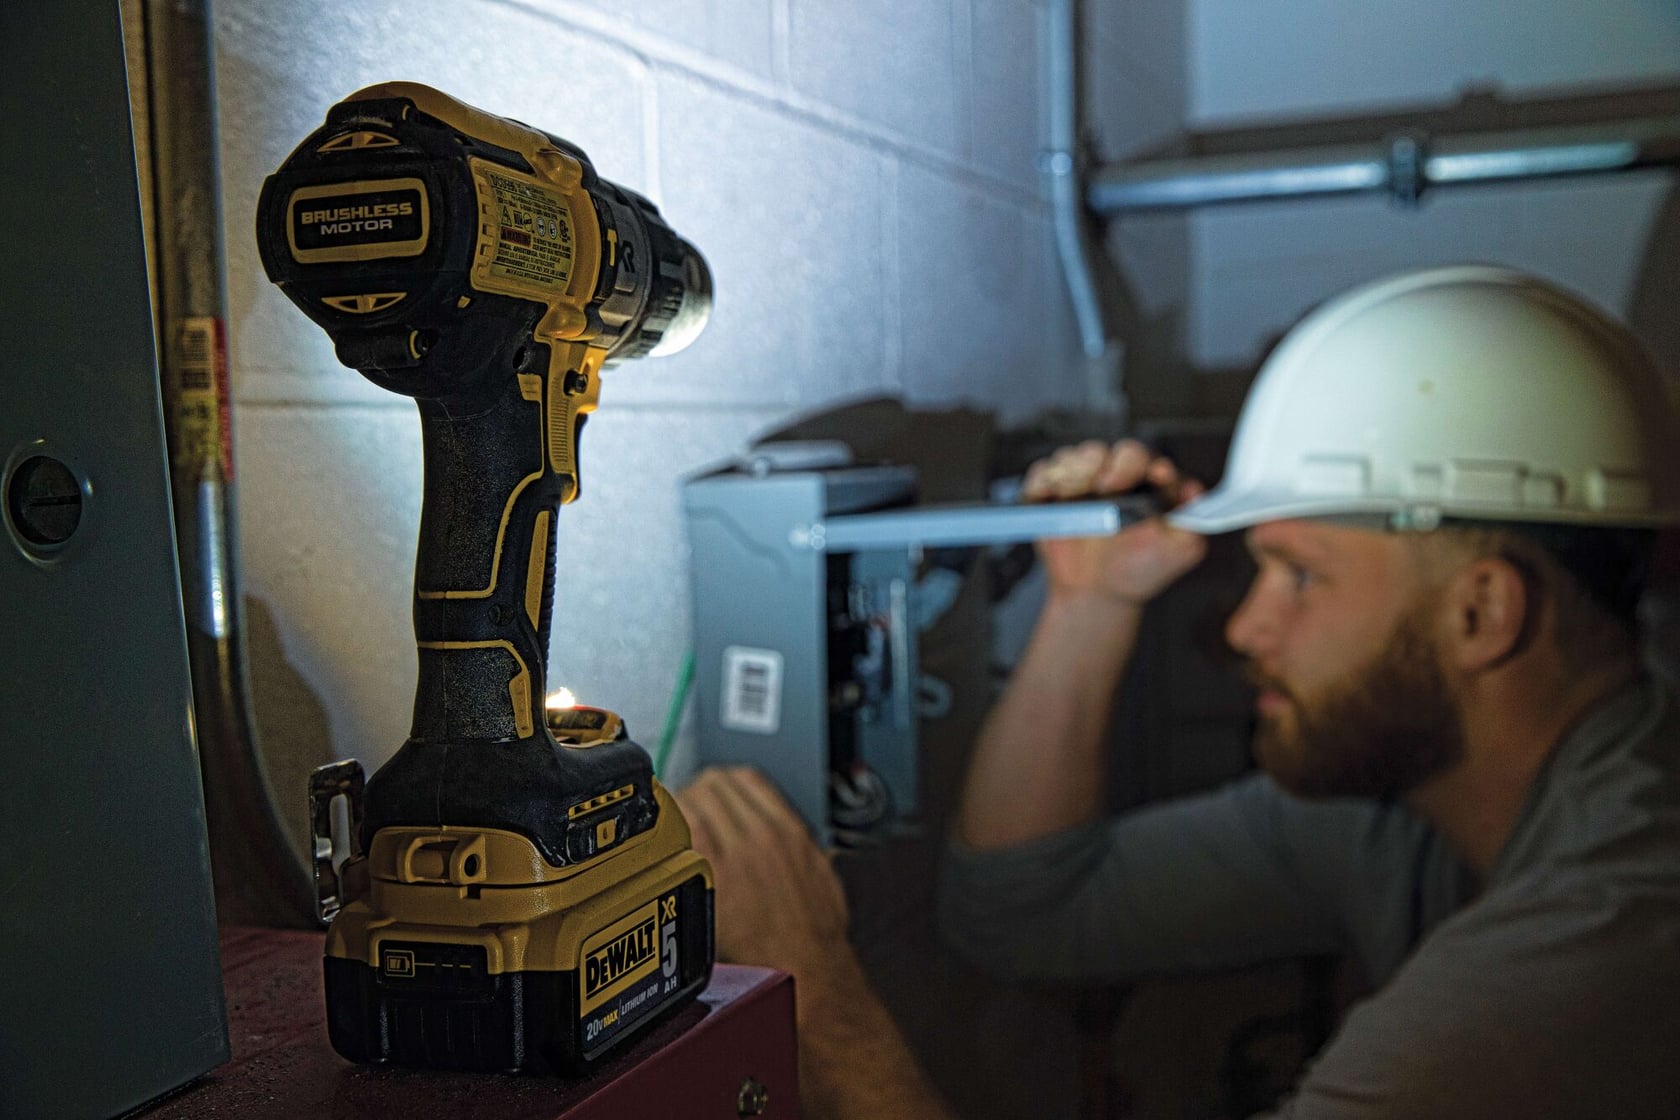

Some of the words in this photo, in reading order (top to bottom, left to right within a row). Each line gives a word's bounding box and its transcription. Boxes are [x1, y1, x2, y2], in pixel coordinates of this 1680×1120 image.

[301, 202, 413, 225] BRUSHLESS
[320, 219, 393, 235] MOTOR
[661, 895, 677, 925] XR
[662, 920, 678, 978] 5
[664, 975, 677, 994] AH
[603, 1009, 619, 1028] MAX
[621, 991, 647, 1015] LITHIUM
[647, 982, 659, 999] ION
